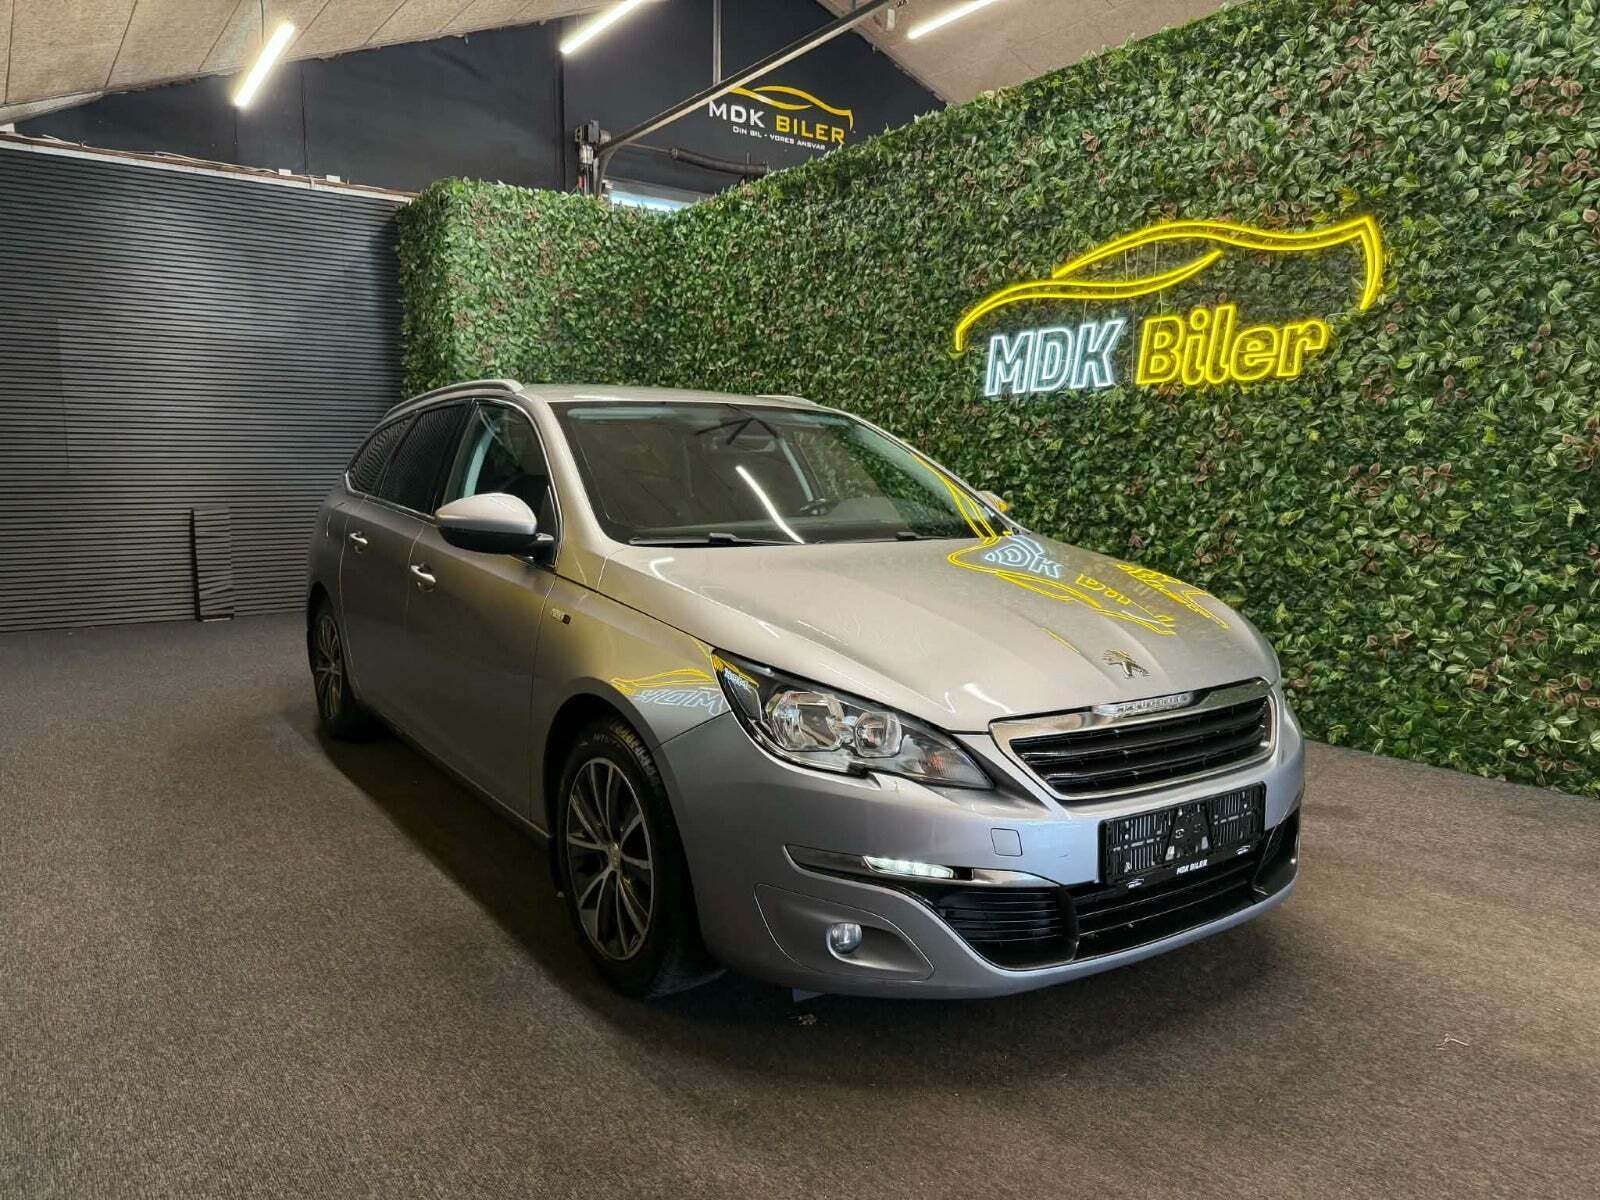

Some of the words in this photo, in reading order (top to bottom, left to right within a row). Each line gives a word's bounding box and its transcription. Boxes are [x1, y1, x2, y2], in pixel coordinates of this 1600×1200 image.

[708, 101, 766, 129] MDK
[776, 114, 846, 145] BILER
[732, 125, 748, 135] DIN
[750, 129, 763, 138] BIL
[984, 316, 1127, 397] MDK
[1136, 304, 1331, 386] Biler
